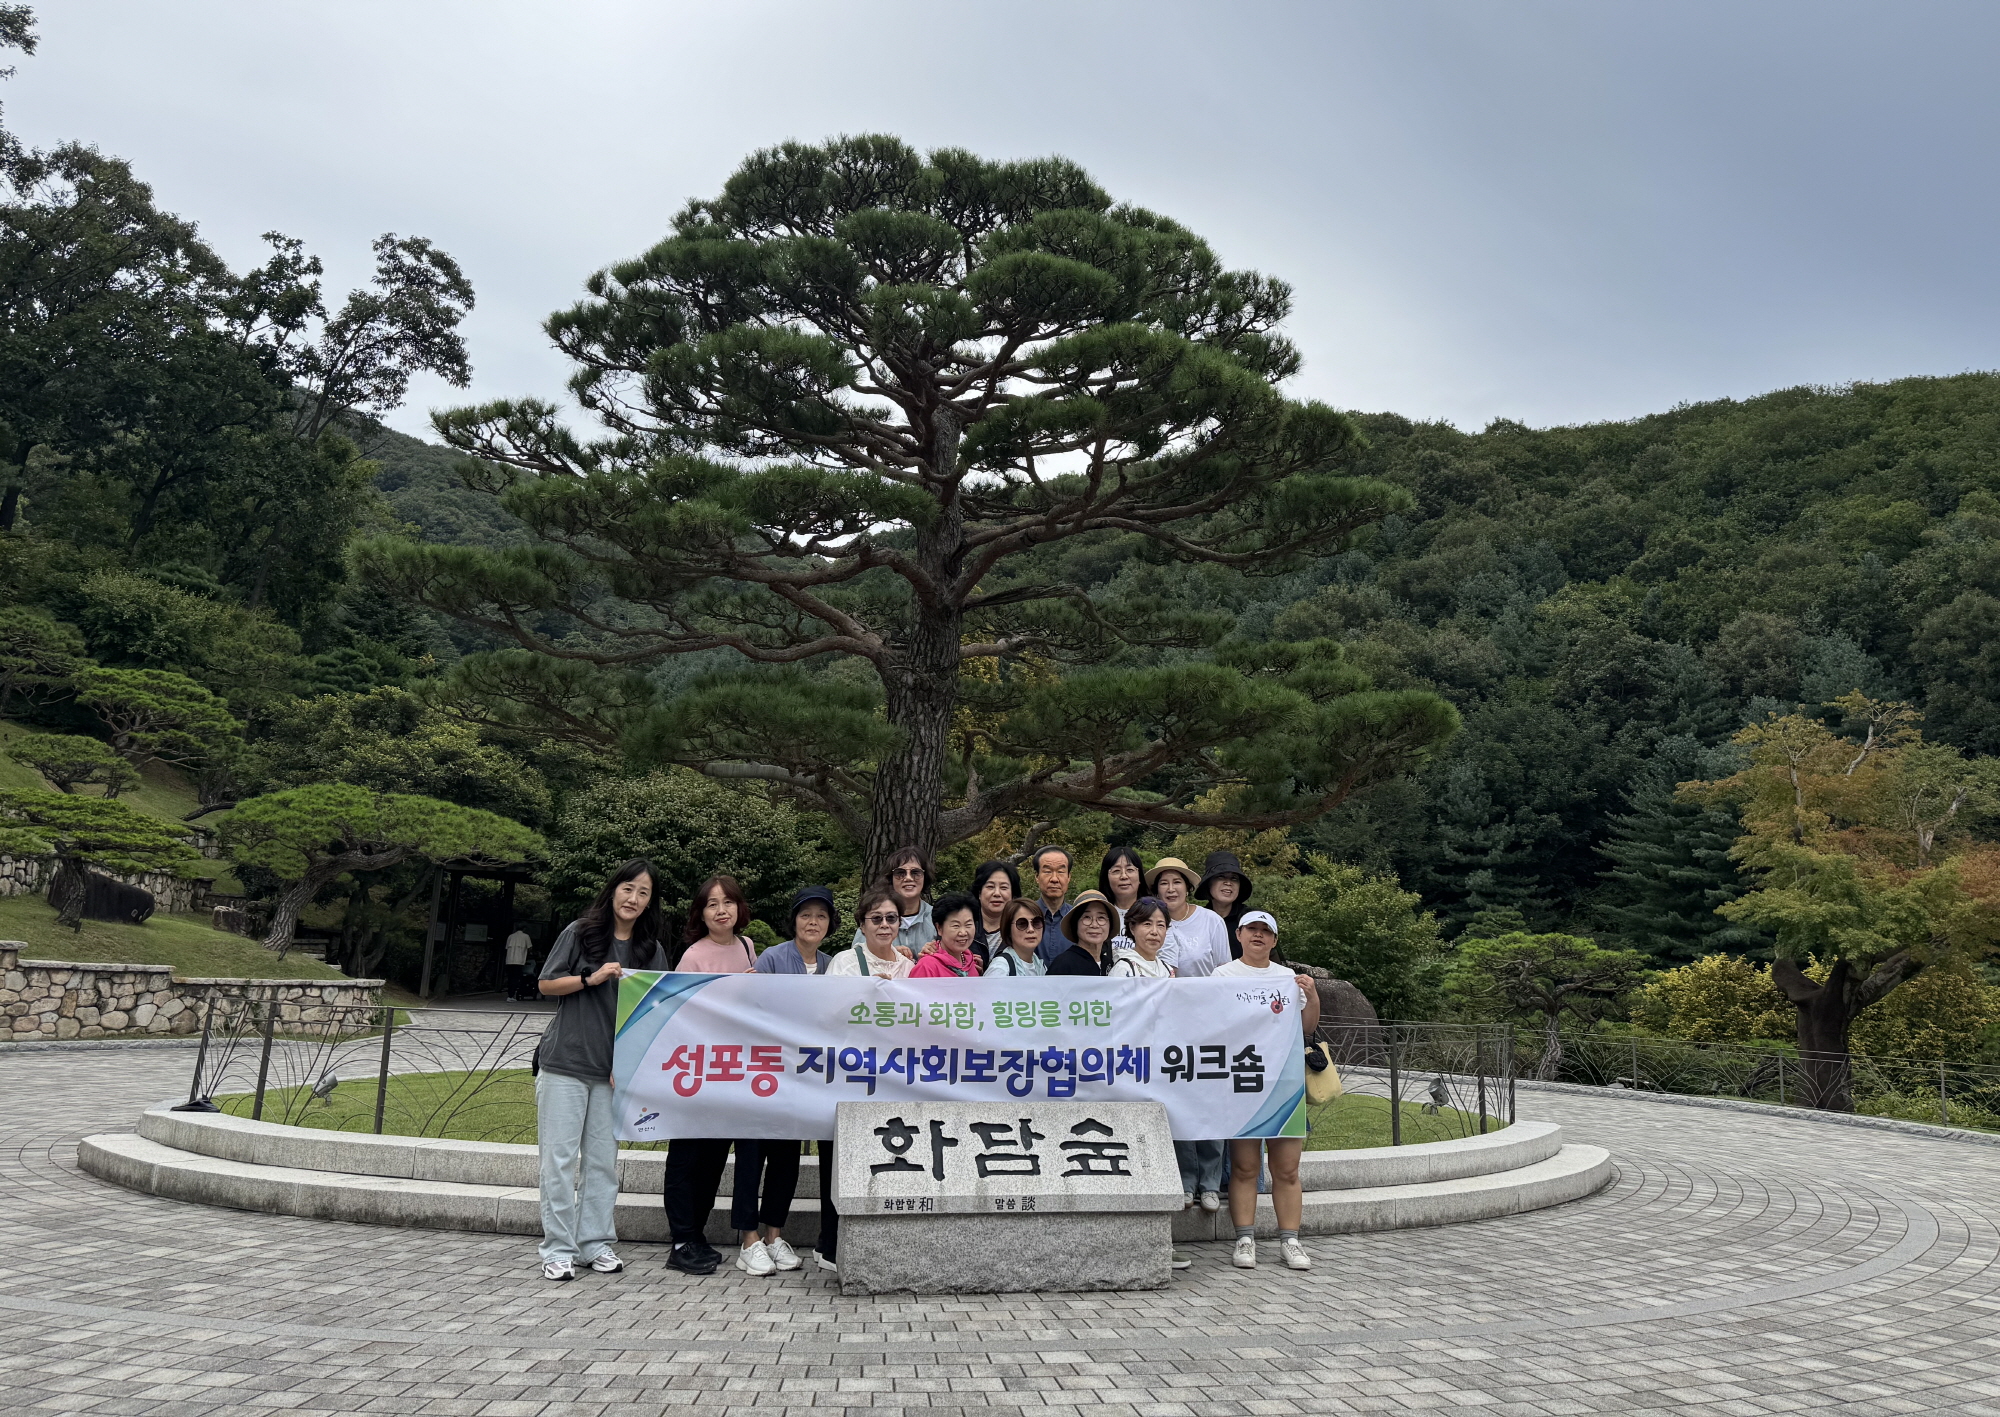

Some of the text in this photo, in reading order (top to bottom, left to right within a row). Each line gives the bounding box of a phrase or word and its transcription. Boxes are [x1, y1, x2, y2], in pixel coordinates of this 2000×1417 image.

[847, 999, 1112, 1031] 소통과 화합, 힐링을 위한
[661, 1044, 1265, 1098] 성포동 지역사회보장협의체 워크숍
[870, 1117, 1132, 1181] 화담숲
[884, 1196, 934, 1212] 화합할 和
[995, 1196, 1036, 1212] 말씀 談
